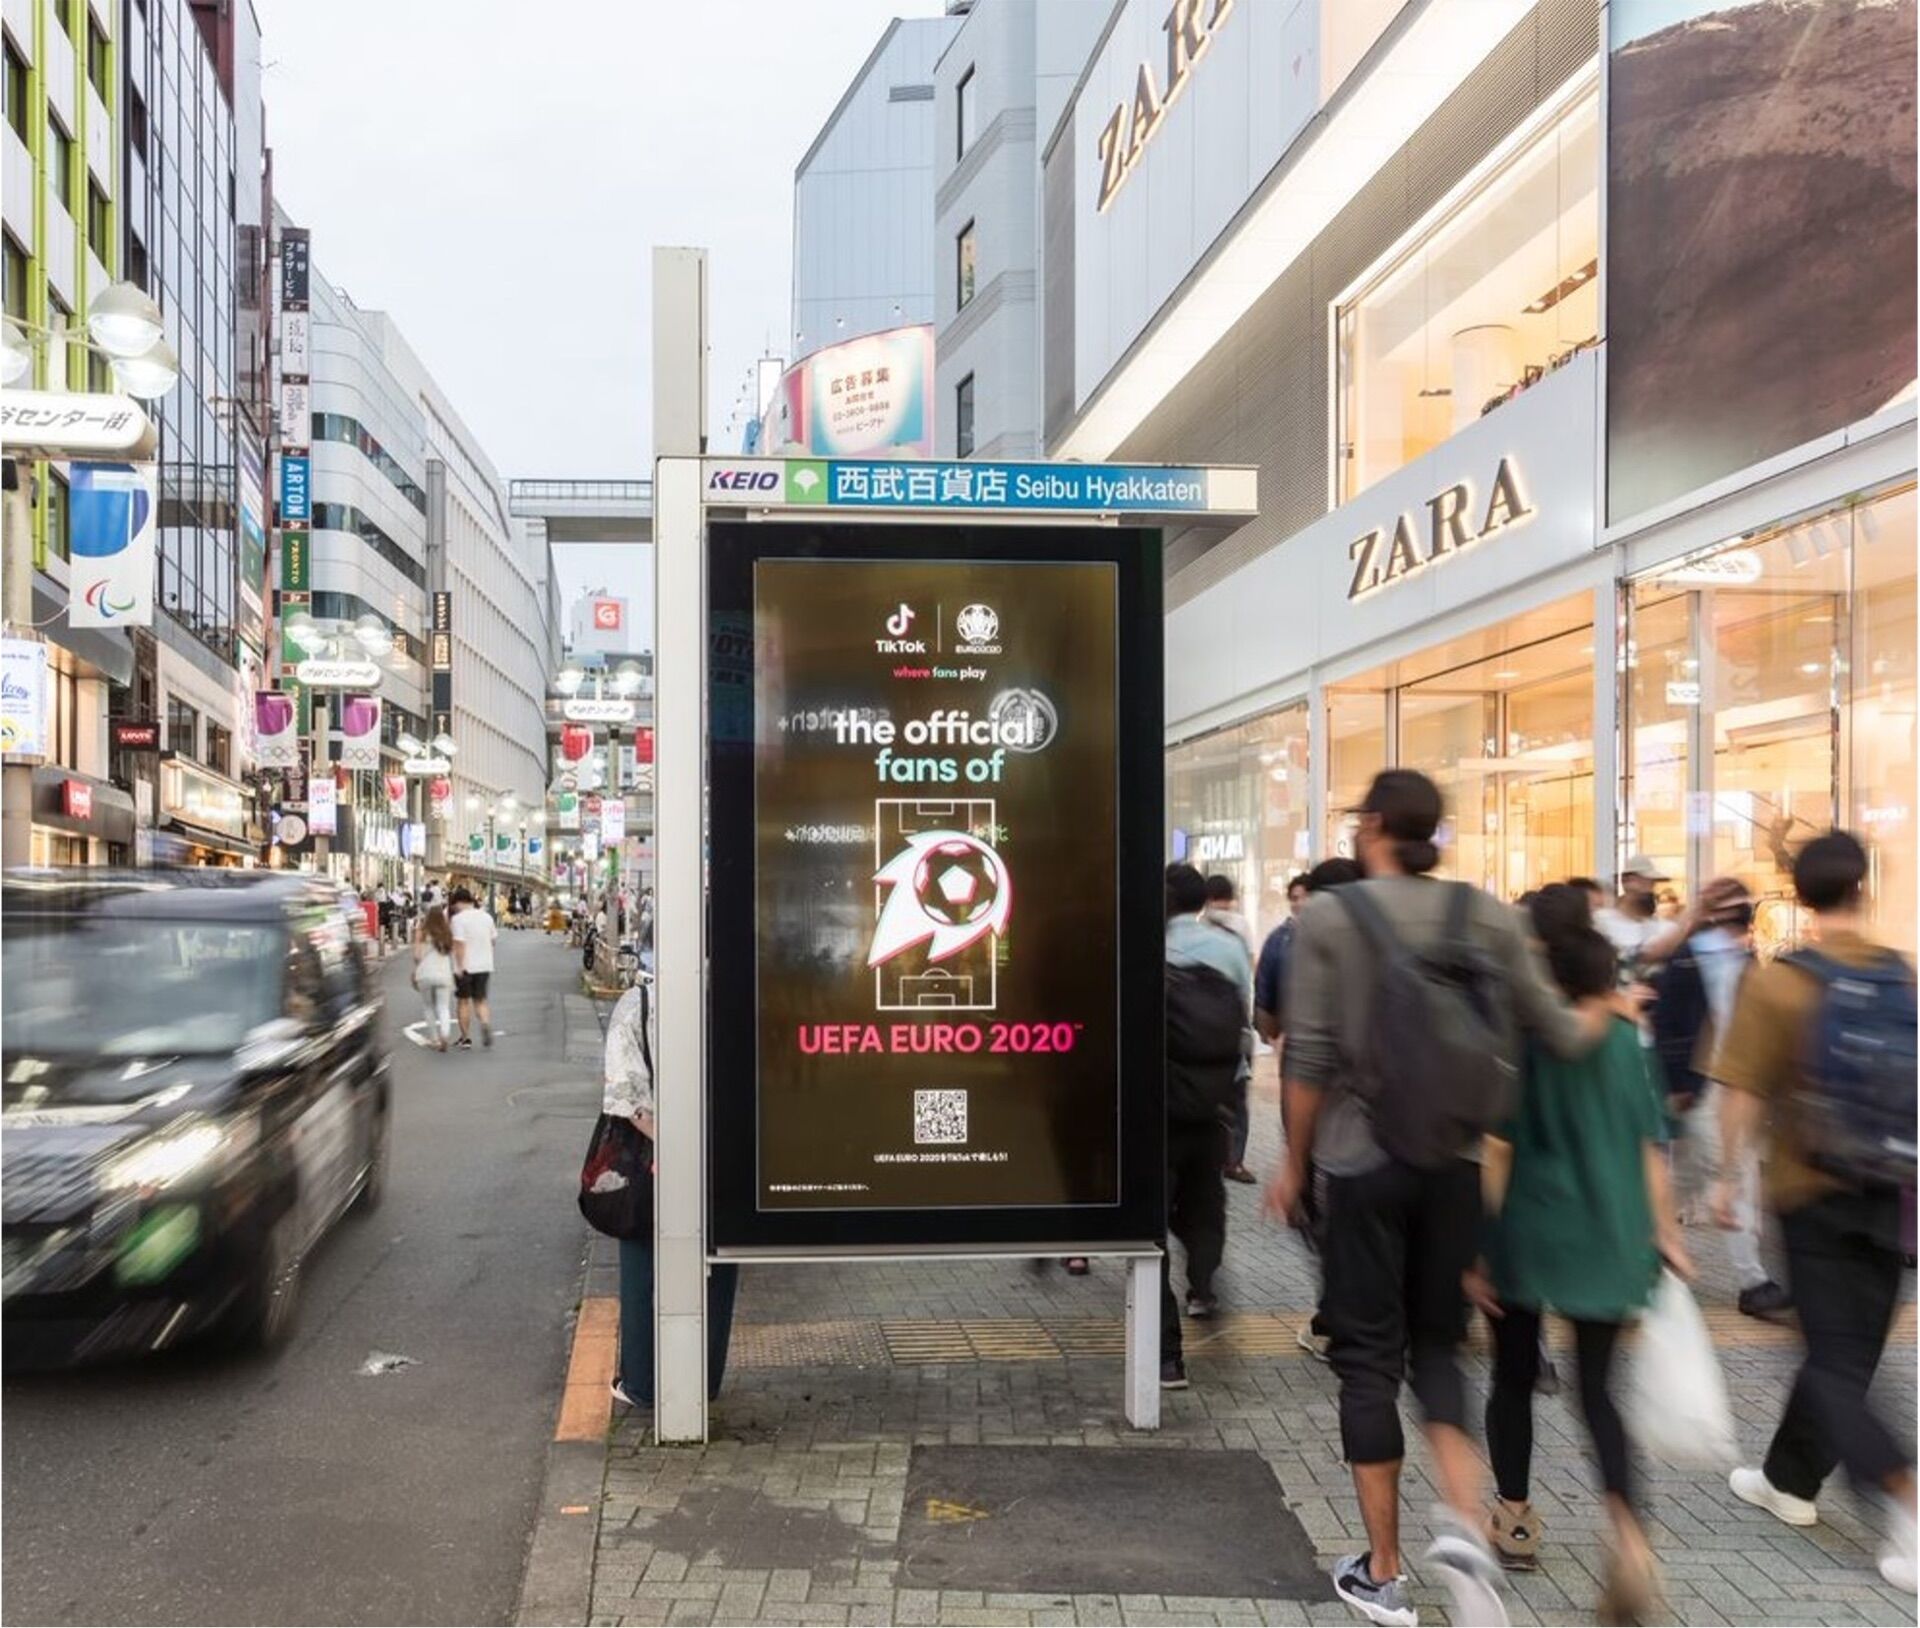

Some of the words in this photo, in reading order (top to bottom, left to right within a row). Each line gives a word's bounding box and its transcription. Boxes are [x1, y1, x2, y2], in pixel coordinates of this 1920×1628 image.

[1097, 0, 1235, 213] ZAR
[830, 367, 890, 395] 広告募集
[286, 463, 305, 515] ARTON
[709, 471, 779, 491] KEIO
[836, 466, 1008, 502] 西武百貨店
[1016, 473, 1079, 499] Seibu
[1086, 475, 1202, 505] Hyakkaten
[1347, 457, 1534, 600] ZARA
[875, 640, 926, 653] TikTok
[893, 666, 930, 678] where
[932, 666, 958, 678] fans
[960, 666, 987, 681] play
[834, 709, 895, 744] the
[904, 709, 1034, 744] official
[874, 748, 958, 782] fans
[966, 748, 1005, 782] of
[799, 1024, 883, 1054] UEFA
[890, 1024, 982, 1054] EURO
[873, 1153, 895, 1163] UEFA
